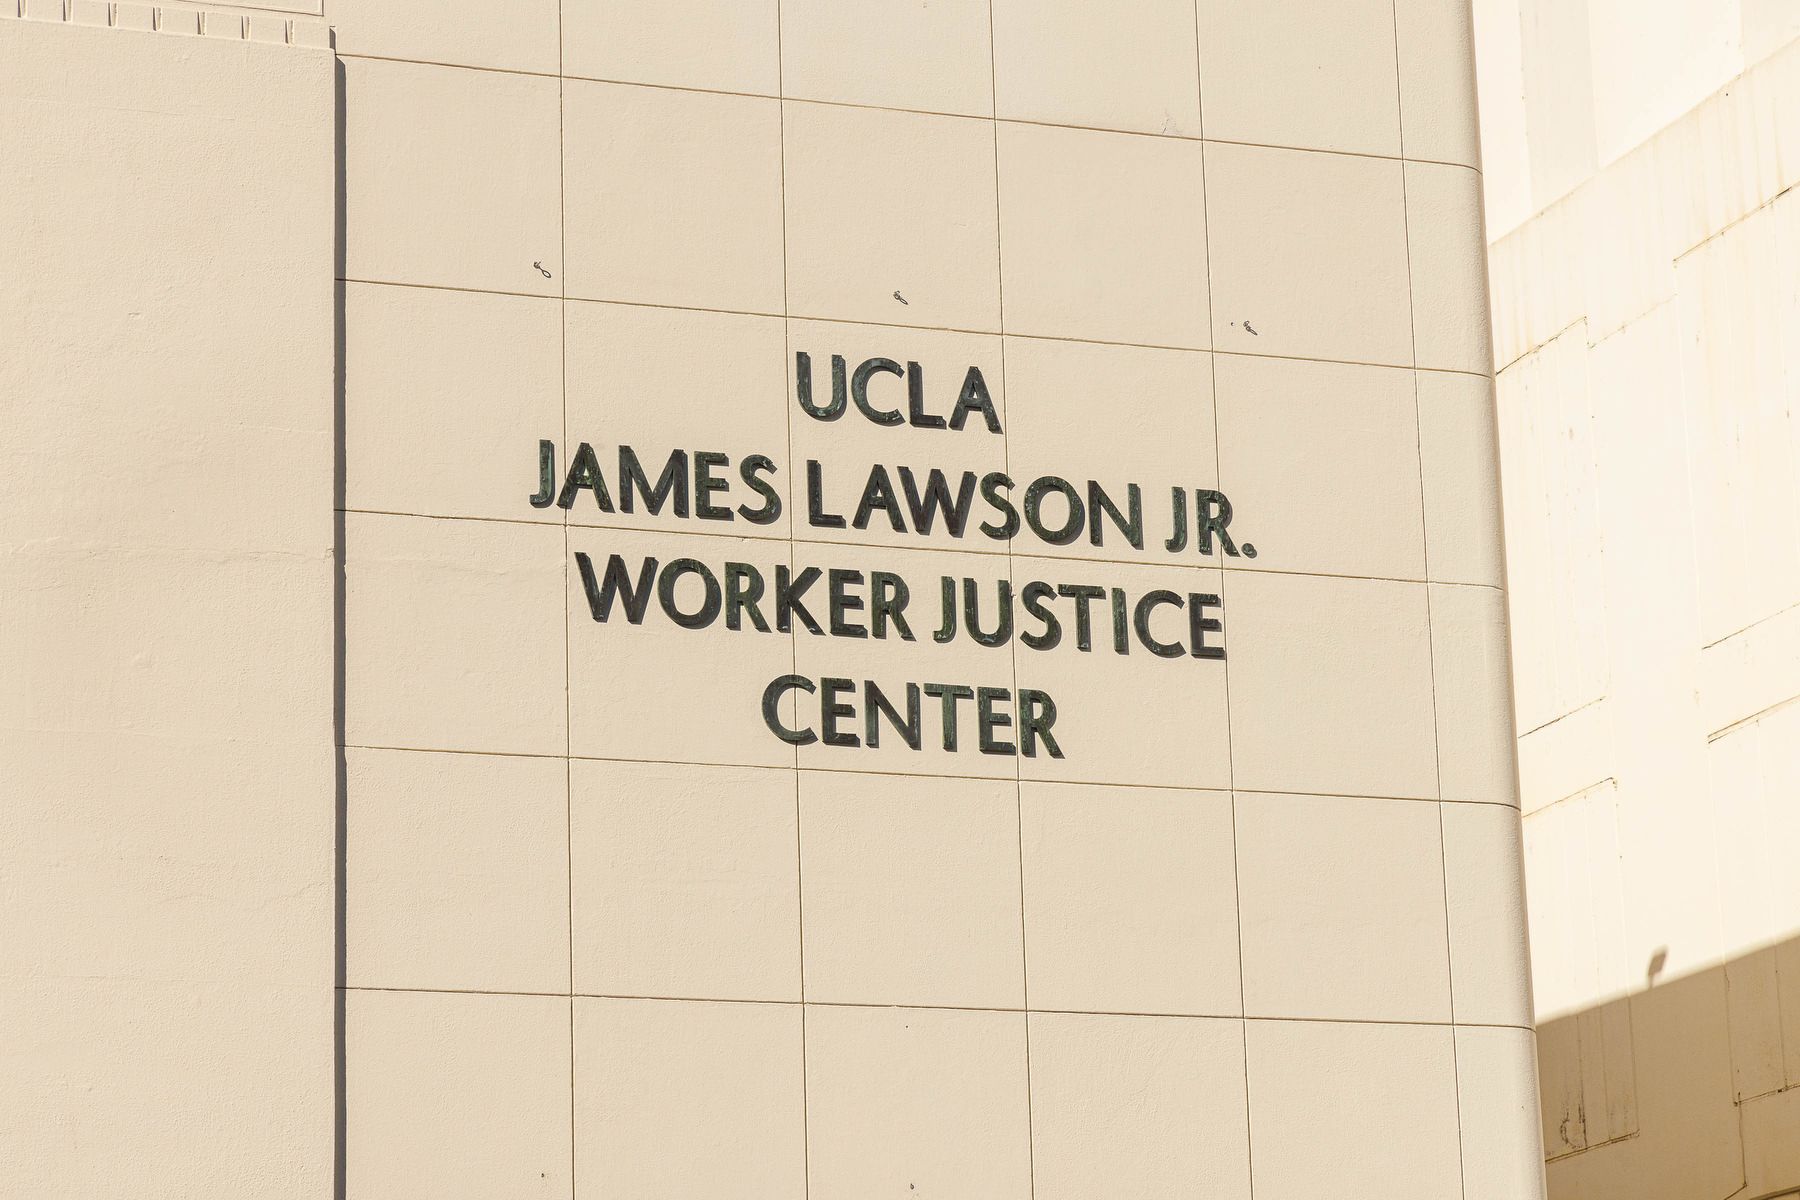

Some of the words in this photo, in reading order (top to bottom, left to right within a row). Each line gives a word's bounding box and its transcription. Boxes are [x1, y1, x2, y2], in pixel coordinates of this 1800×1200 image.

[797, 352, 1003, 434] UCLA
[530, 440, 781, 525] JAMES
[807, 459, 1144, 550] LAWSON
[1165, 487, 1258, 558] JR.
[575, 552, 916, 642] WORKER
[933, 576, 1226, 660] JUSTICE
[762, 675, 1064, 758] CENTER
